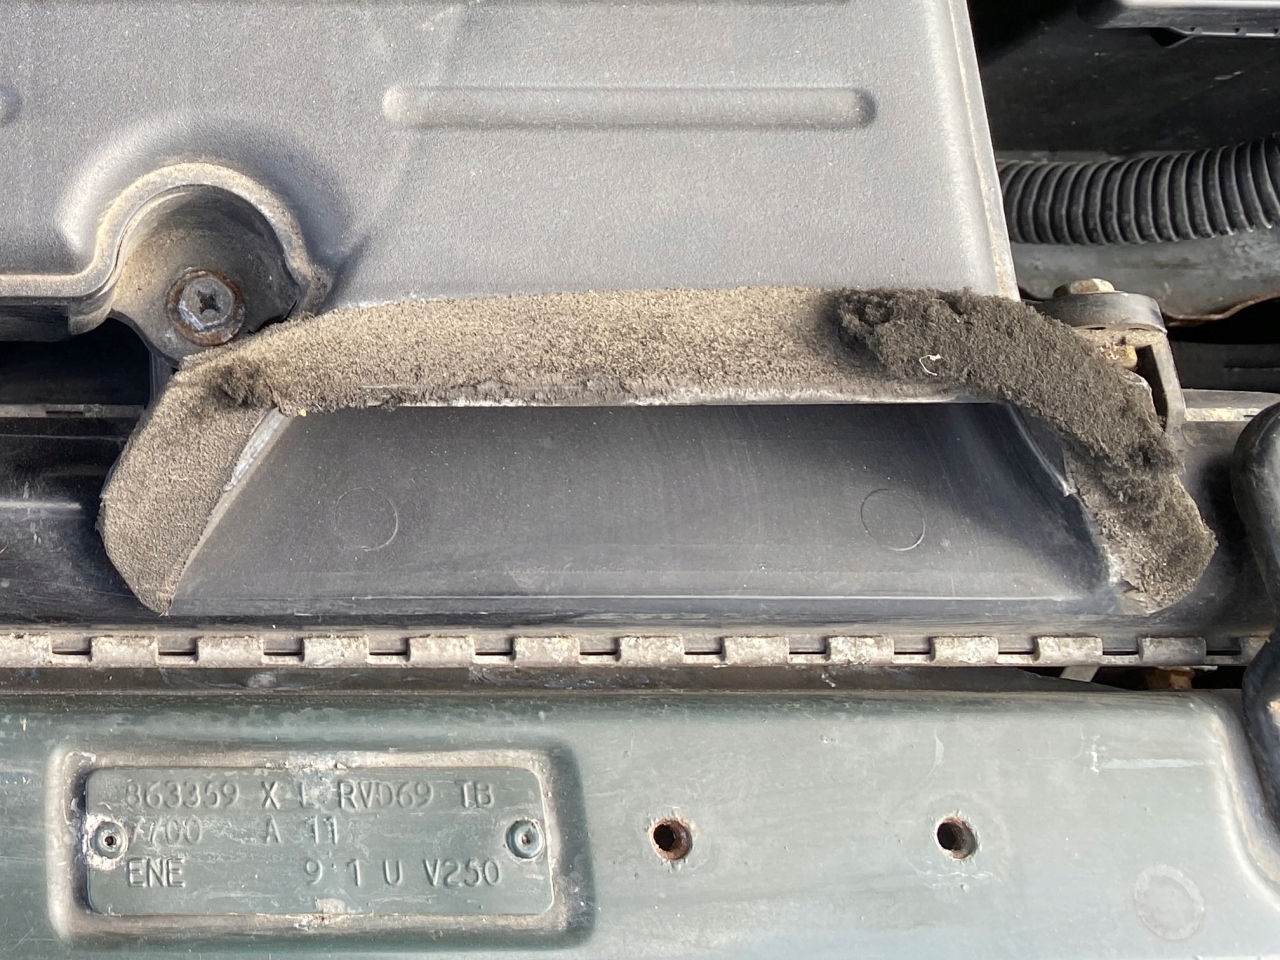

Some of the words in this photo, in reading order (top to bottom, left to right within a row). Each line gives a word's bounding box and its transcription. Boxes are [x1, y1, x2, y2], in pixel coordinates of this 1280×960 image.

[261, 779, 281, 809] X
[265, 813, 283, 844] A
[127, 856, 187, 888] ENE
[382, 858, 404, 887] U
